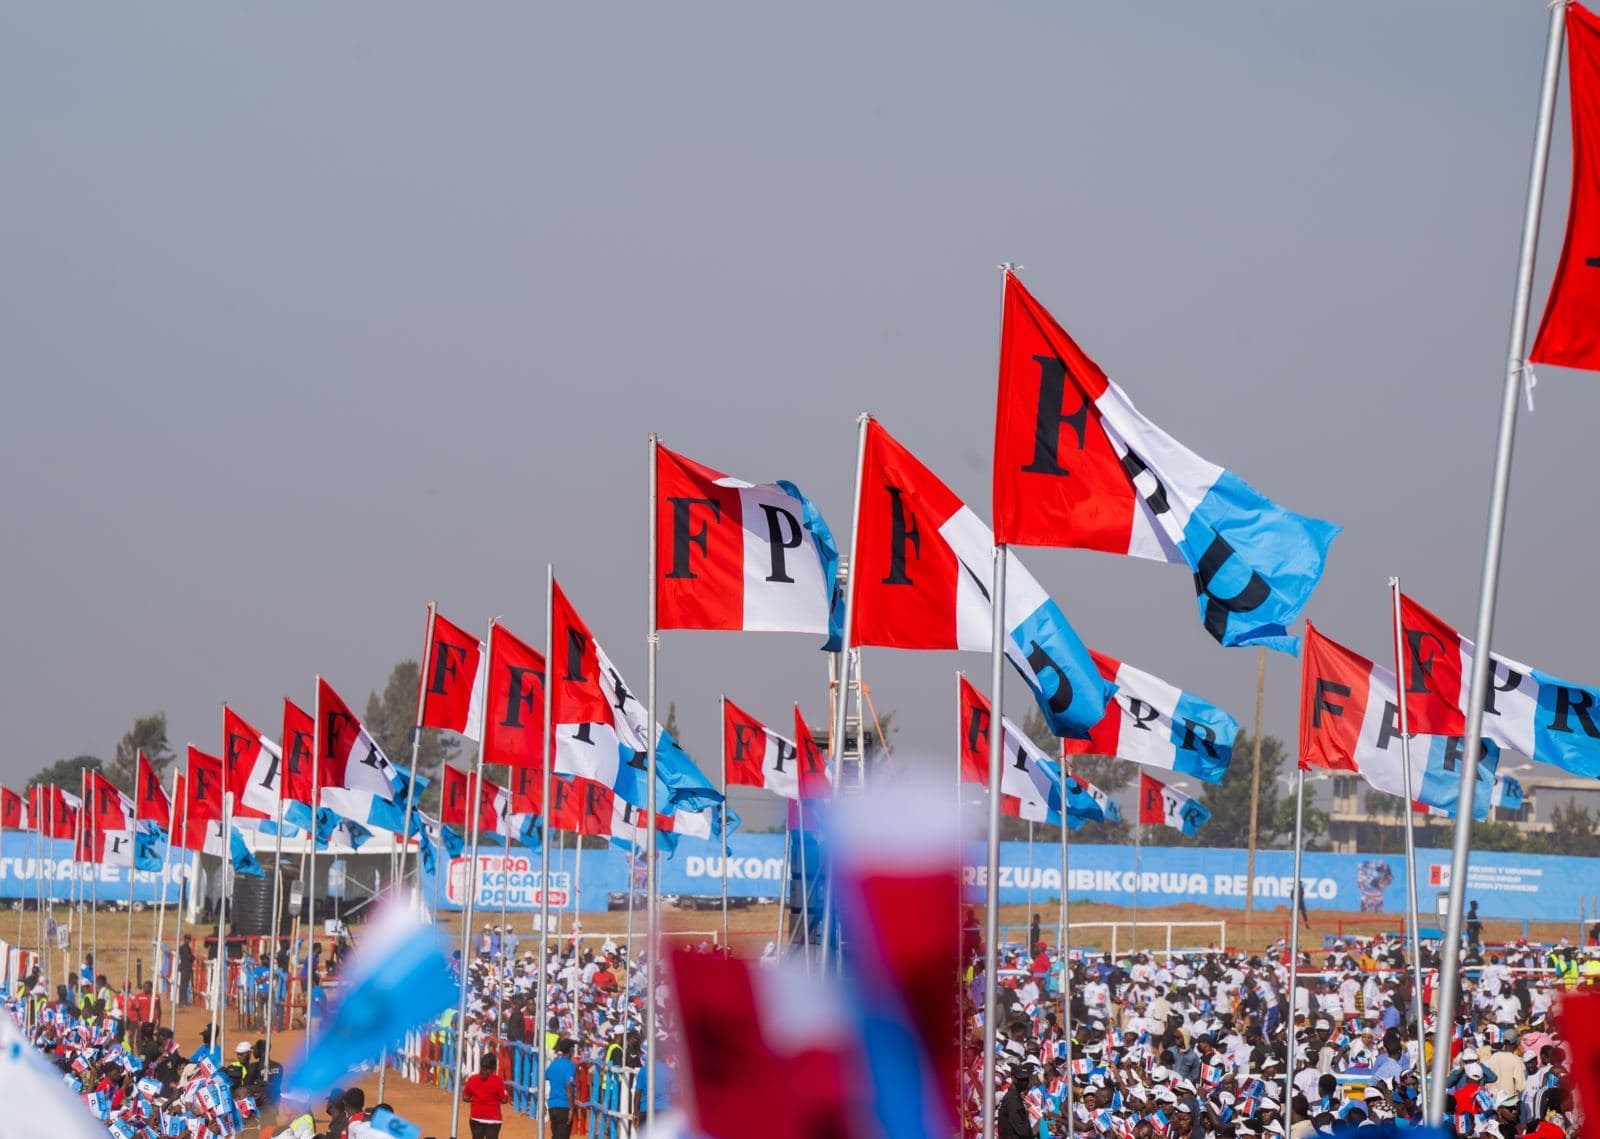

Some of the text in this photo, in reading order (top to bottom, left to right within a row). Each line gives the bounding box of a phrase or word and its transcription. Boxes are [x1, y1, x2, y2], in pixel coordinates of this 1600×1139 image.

[664, 496, 803, 583] F P
[427, 640, 466, 696] F
[1402, 629, 1446, 694] F
[1546, 685, 1600, 738] R
[500, 665, 546, 729] F
[1312, 677, 1352, 728] F
[325, 711, 351, 759] F
[734, 724, 759, 762] F
[481, 889, 533, 903] PAUL
[482, 872, 568, 888] KAGAME
[1068, 869, 1208, 895] IBIKORWA
[1214, 874, 1338, 900] REMEZO
[260, 1067, 280, 1077] PLICE
